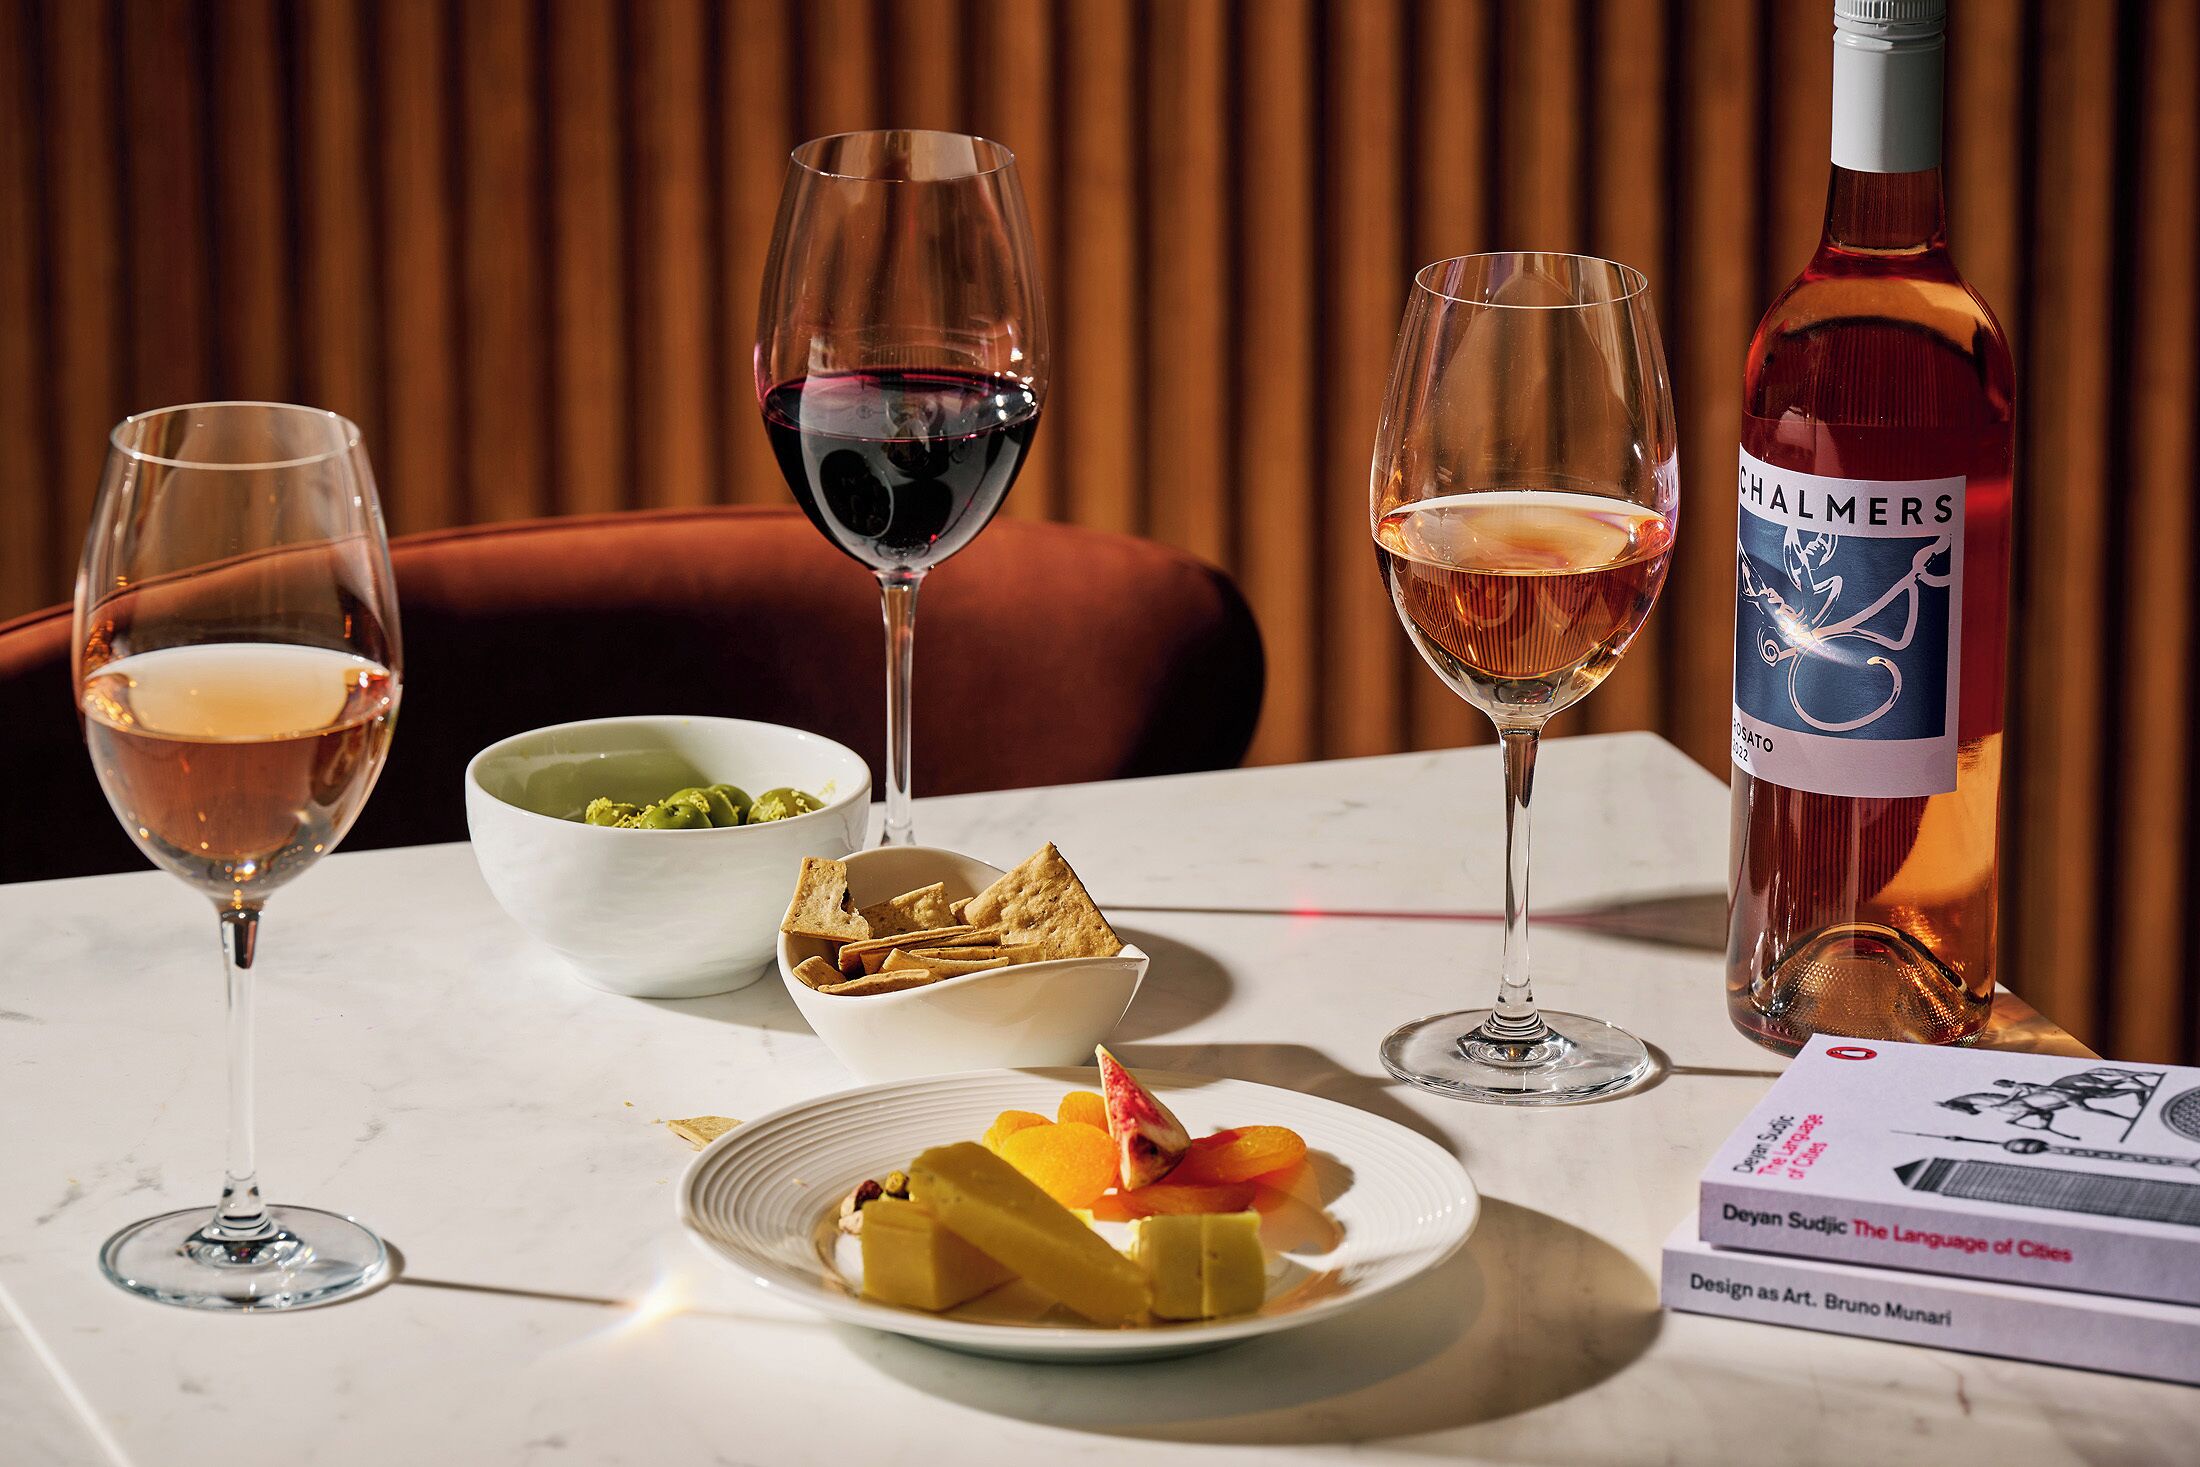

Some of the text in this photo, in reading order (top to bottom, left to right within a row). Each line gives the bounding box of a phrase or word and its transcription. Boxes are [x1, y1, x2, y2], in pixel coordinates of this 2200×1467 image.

[1740, 465, 1953, 525] CHALMERS
[1733, 1115, 1794, 1173] Deyan Sudjic
[1756, 1114, 1823, 1176] The Language
[1786, 1141, 1828, 1180] of Cities
[1723, 1203, 2073, 1263] Deyan Sudjic The Language of Cities
[1690, 1272, 1953, 1327] Design as Art. Bruno Munari
